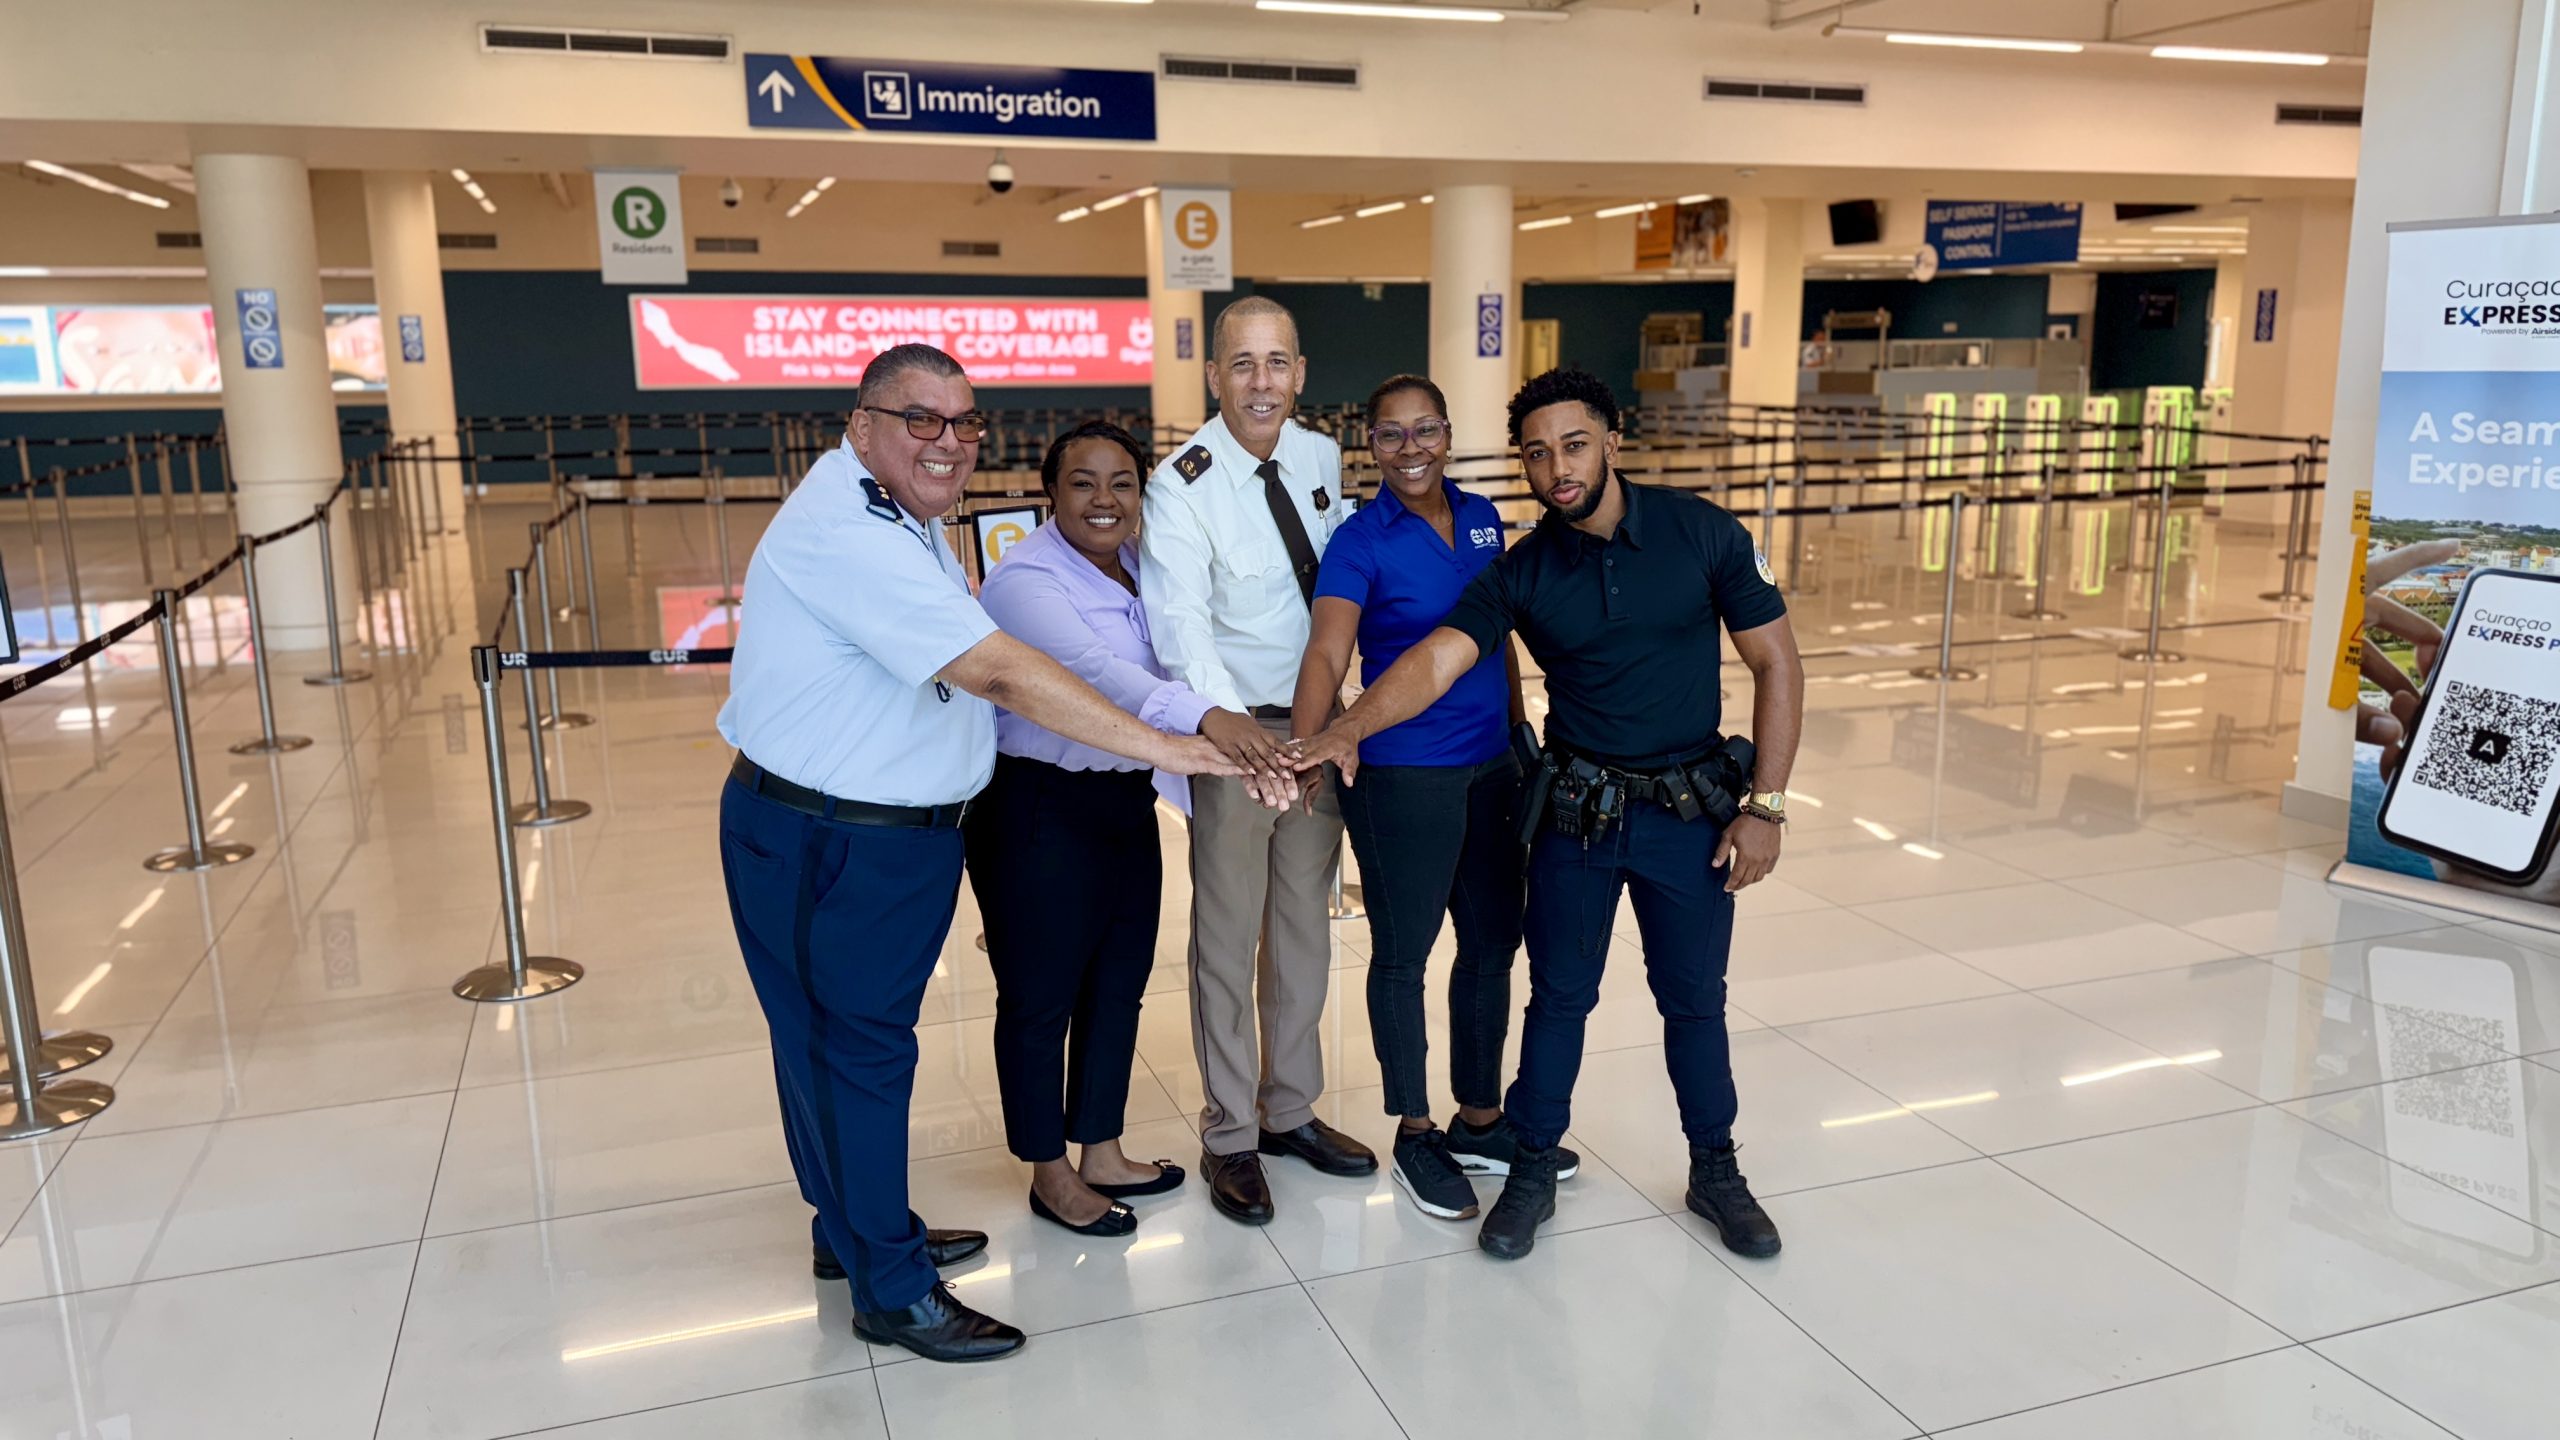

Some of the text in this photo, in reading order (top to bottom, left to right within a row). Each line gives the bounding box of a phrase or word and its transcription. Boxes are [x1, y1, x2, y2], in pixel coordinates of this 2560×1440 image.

[918, 82, 1100, 123] Immigration
[625, 196, 655, 230] R
[1954, 203, 1996, 220] SERVICE
[1187, 211, 1208, 241] E
[1942, 223, 1996, 241] PASSPORT
[612, 242, 673, 254] Residents
[1944, 243, 1993, 261] CONTROL
[753, 306, 1098, 332] STAY CONNECTED WITH
[2444, 304, 2560, 327] EXPRESS
[2481, 327, 2517, 335] Powered
[2518, 327, 2529, 336] by
[954, 333, 1109, 358] COVERAGE
[2409, 411, 2560, 446] A Seam
[1470, 527, 1498, 545] CUR
[2474, 608, 2552, 632] Curaçao
[2467, 624, 2546, 649] EXPRESS
[501, 650, 689, 666] UR CUR
